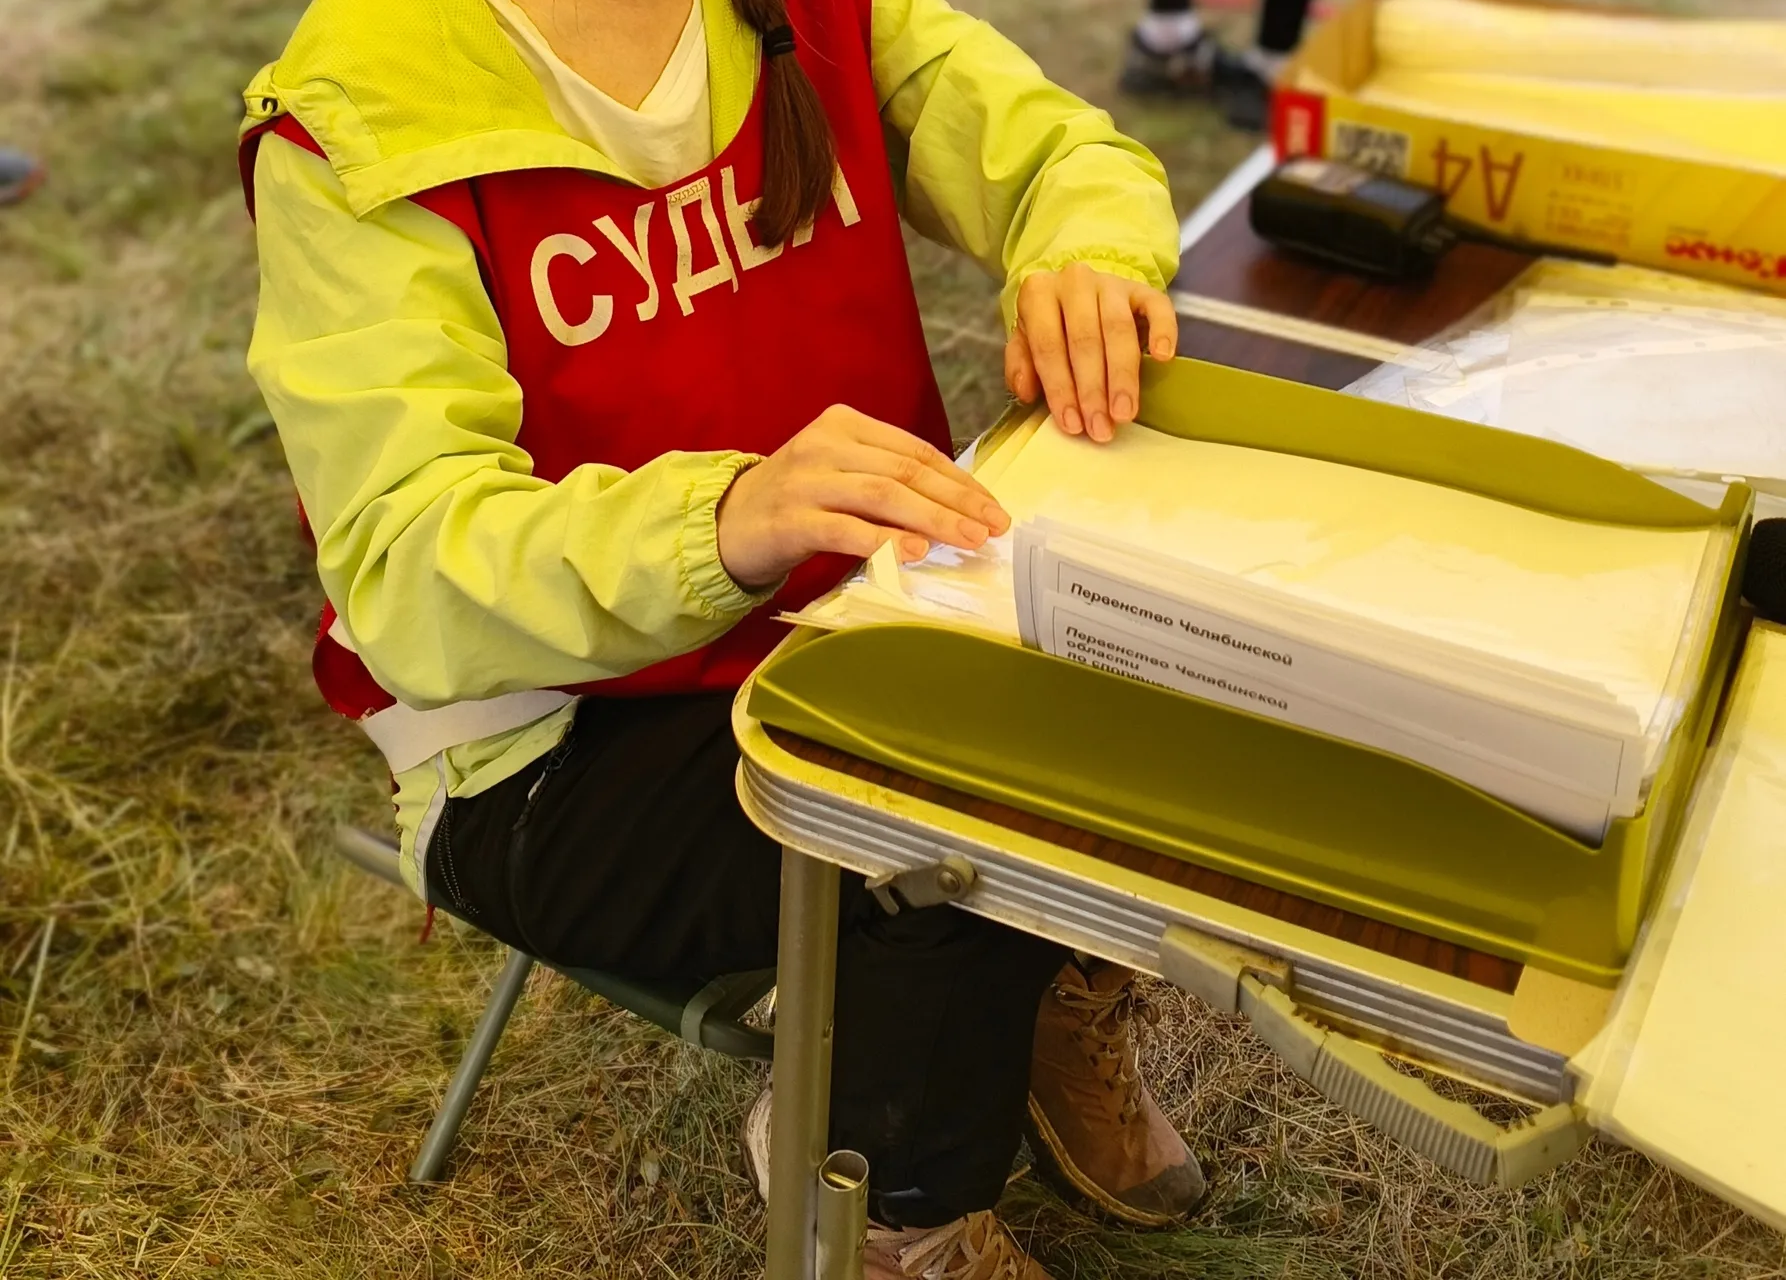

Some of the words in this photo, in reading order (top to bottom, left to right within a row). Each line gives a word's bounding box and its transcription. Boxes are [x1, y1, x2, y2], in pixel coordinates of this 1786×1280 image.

[1070, 582, 1174, 627] Первенство
[1179, 618, 1293, 667] Челябинской
[1066, 639, 1140, 672] области
[1066, 626, 1170, 670] Первенство
[1175, 663, 1288, 711] Челябинской
[1067, 650, 1088, 664] по
